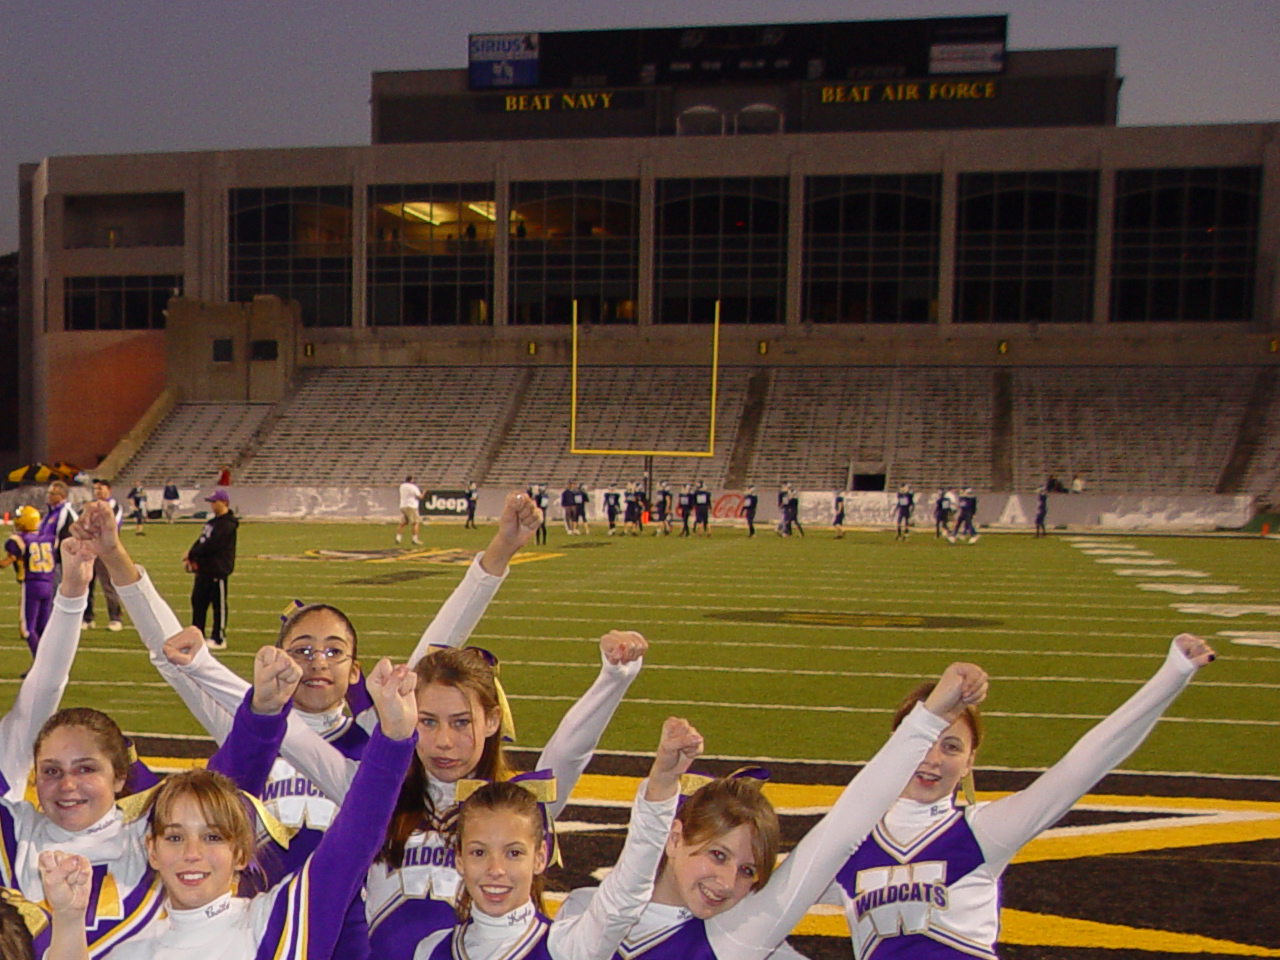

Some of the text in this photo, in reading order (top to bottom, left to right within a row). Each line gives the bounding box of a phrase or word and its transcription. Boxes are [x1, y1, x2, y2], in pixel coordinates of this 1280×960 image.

[470, 38, 521, 53] SIRIUS
[505, 92, 613, 111] BEAT NAVY
[822, 80, 995, 103] BEAT AIR FORCE
[425, 494, 468, 512] Jeep
[28, 541, 55, 573] 25
[262, 777, 333, 803] WILDC
[856, 882, 947, 917] WILDCATS
